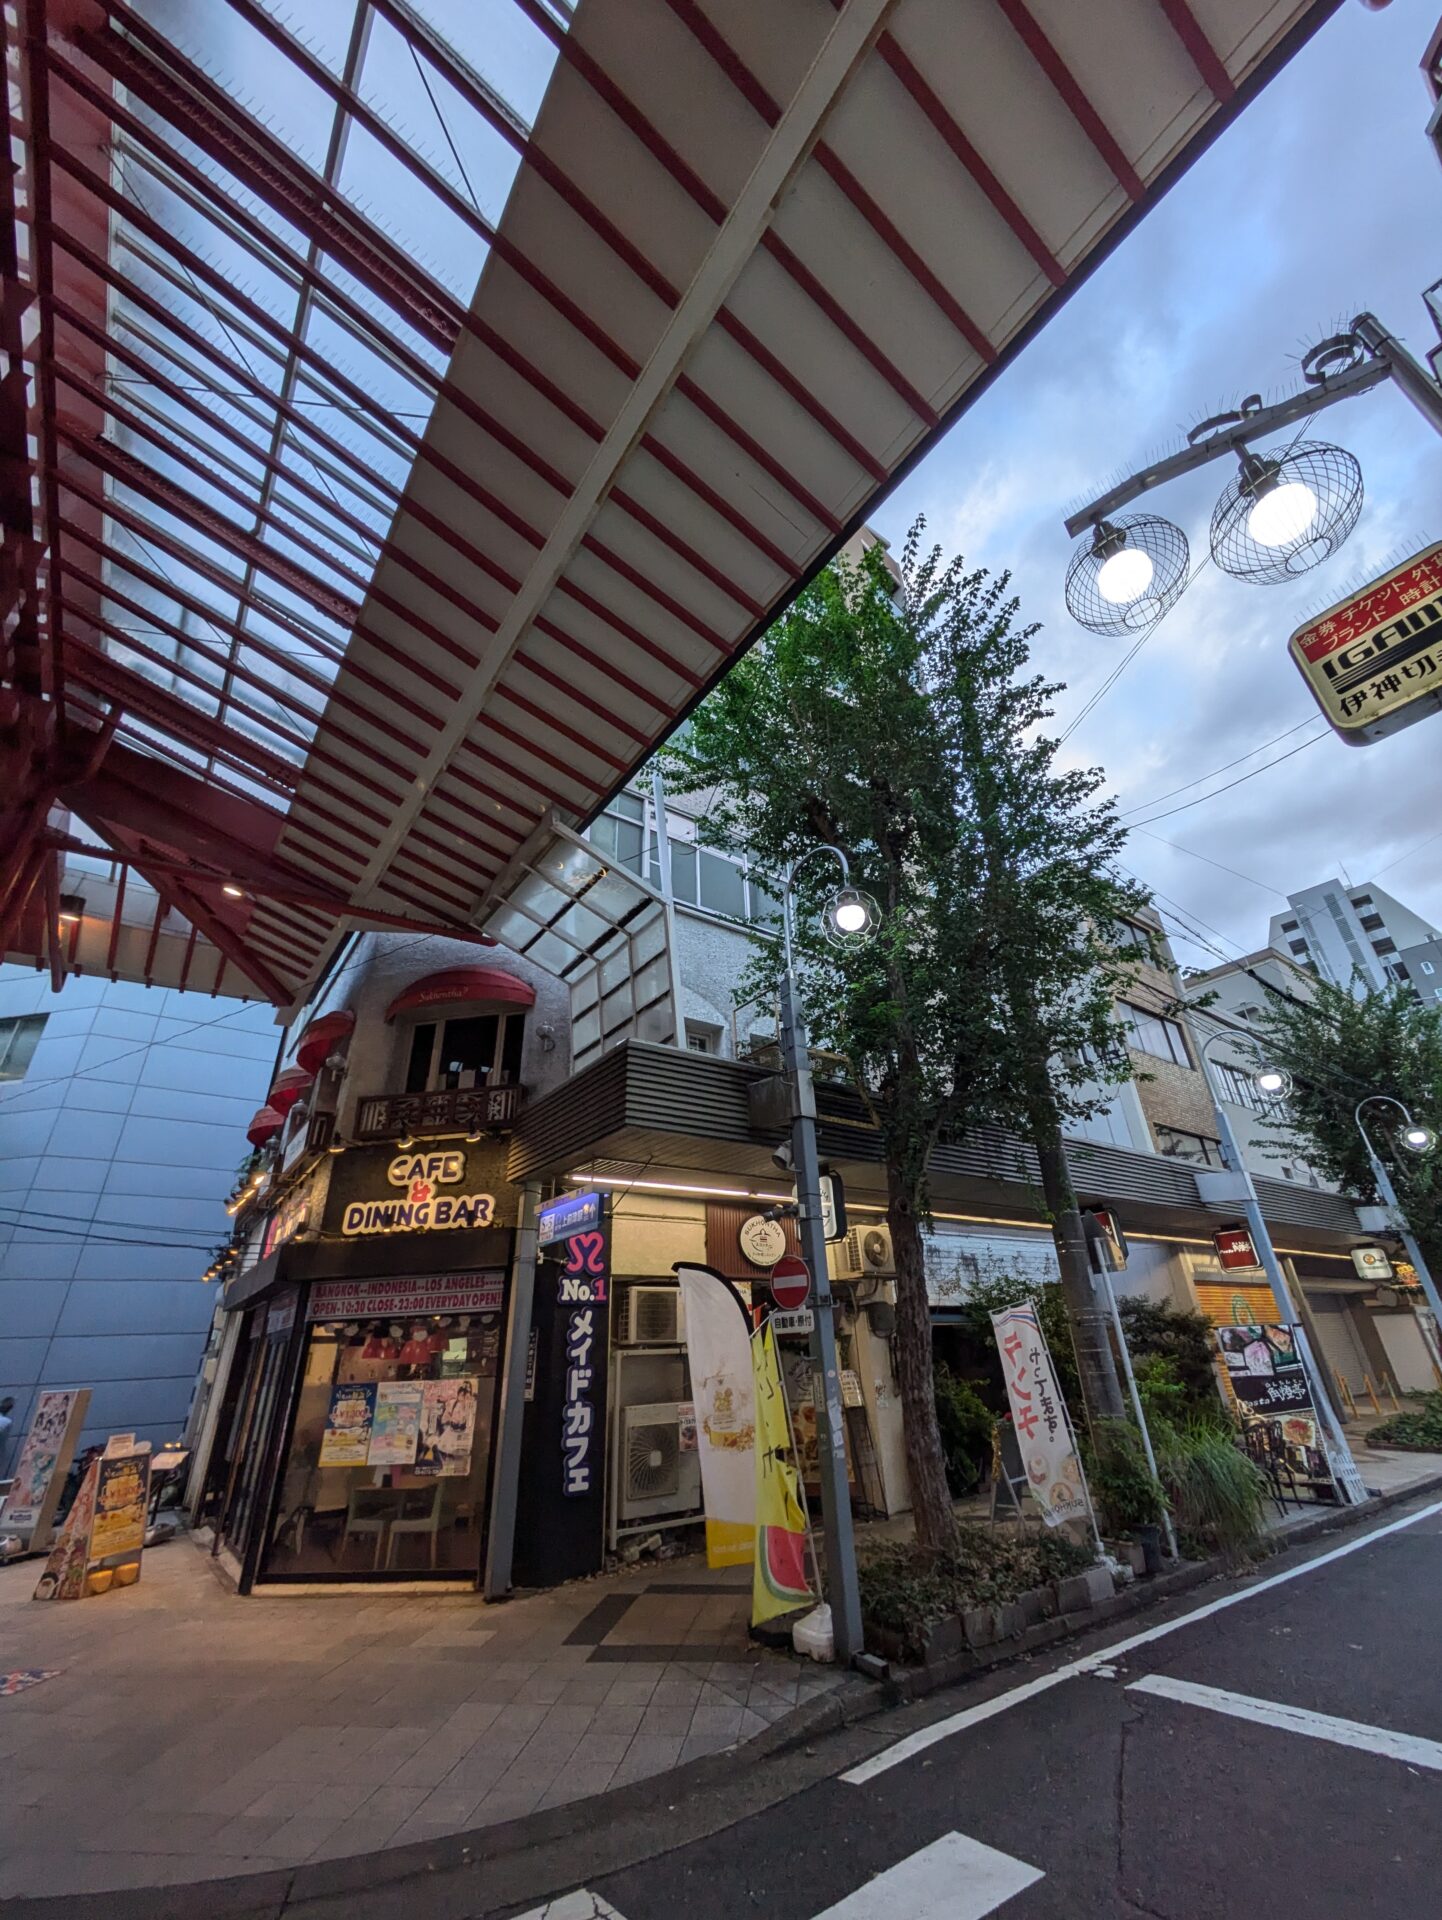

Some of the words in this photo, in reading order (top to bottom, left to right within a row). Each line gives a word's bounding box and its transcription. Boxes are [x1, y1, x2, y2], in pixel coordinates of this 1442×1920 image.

[1299, 620, 1337, 649] 金券
[1342, 579, 1406, 623] チケット
[1321, 605, 1388, 651] ブランド
[1399, 574, 1441, 606] 時計
[1339, 649, 1442, 717] 伊神切
[390, 1154, 461, 1183] CAFE
[411, 1180, 431, 1203] &
[346, 1201, 431, 1231] DINING
[433, 1198, 491, 1226] BAR
[424, 1293, 472, 1310] EVERYDAY
[561, 1279, 607, 1302] No.1
[565, 1310, 594, 1493] メイドカフェ
